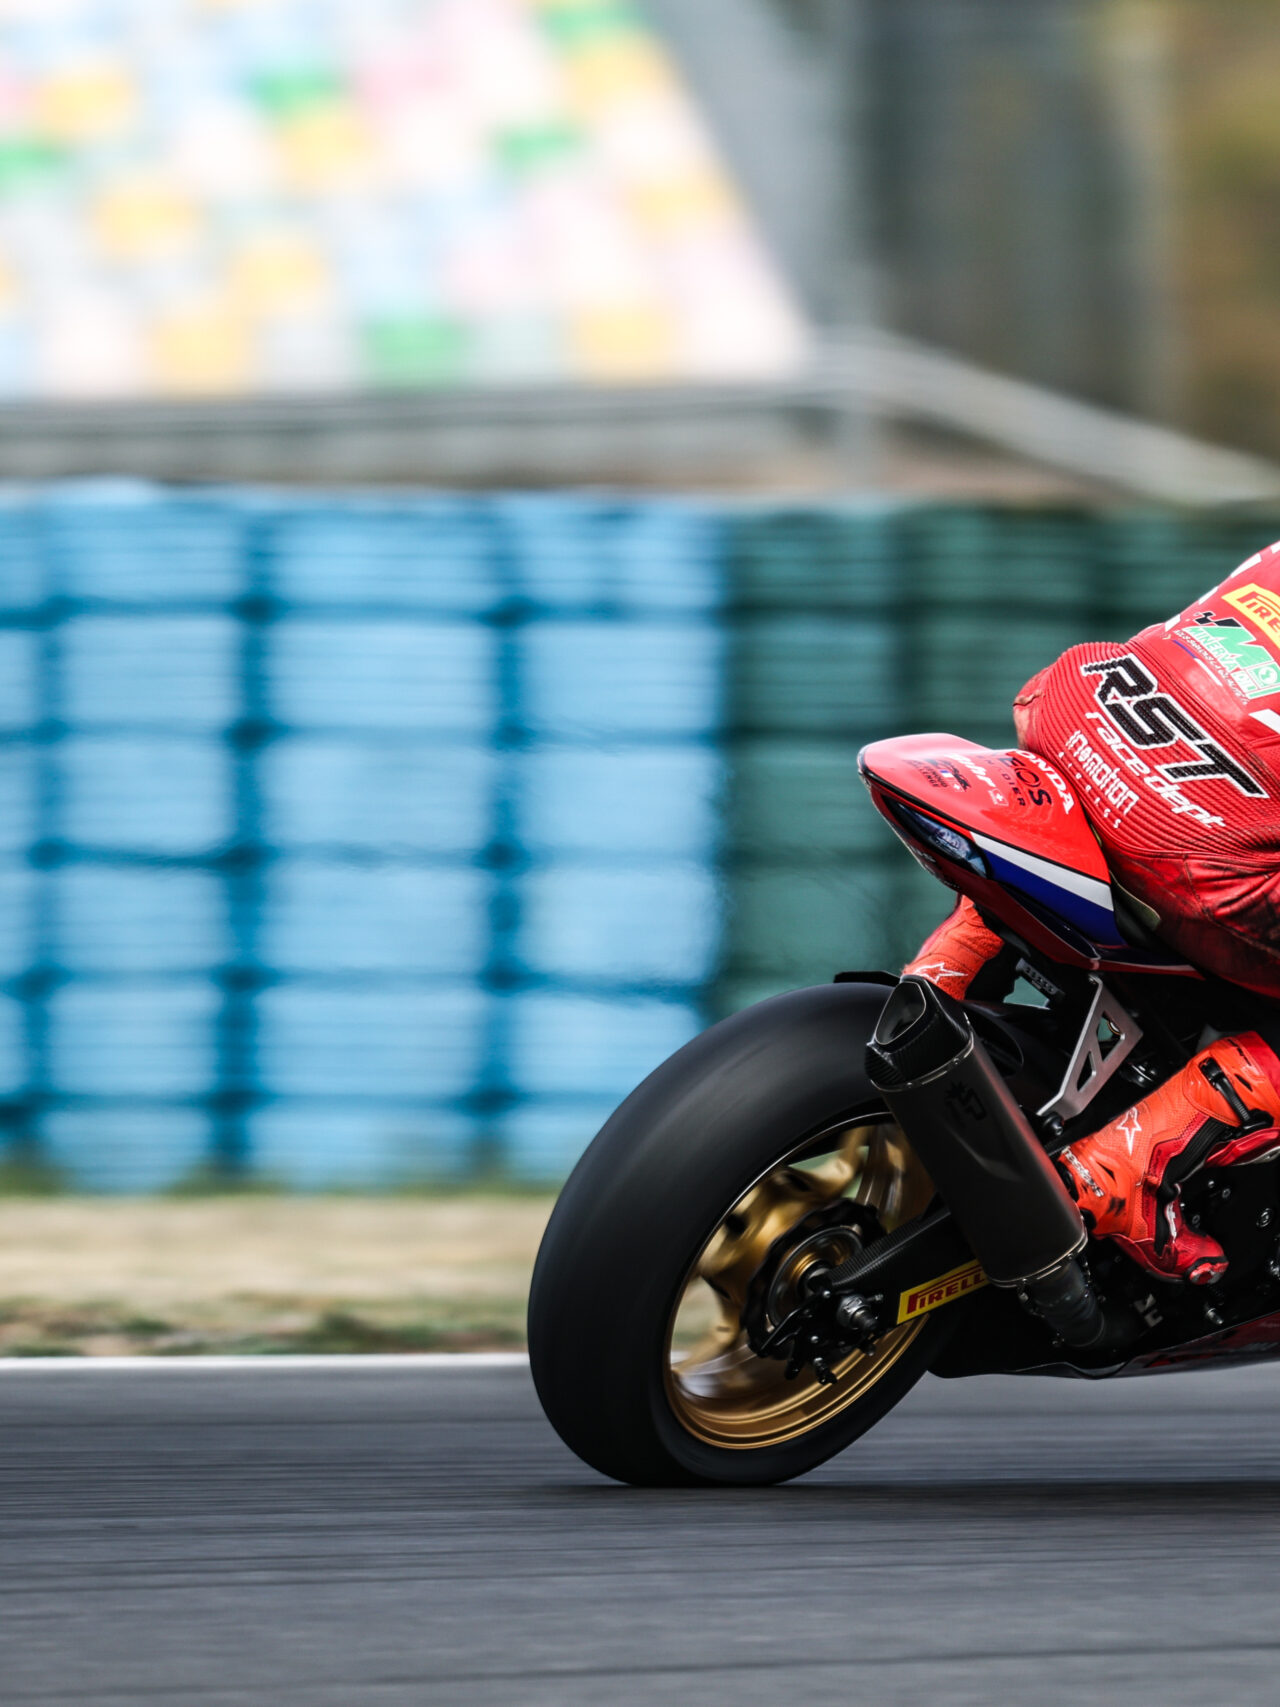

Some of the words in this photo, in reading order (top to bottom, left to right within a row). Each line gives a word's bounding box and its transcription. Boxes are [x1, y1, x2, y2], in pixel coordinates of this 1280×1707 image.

[1184, 626, 1239, 672] MINERVA
[1080, 652, 1270, 799] RST
[1010, 750, 1075, 815] ONDA
[1085, 711, 1151, 777] race
[1143, 774, 1226, 829] dept
[905, 1262, 987, 1316] PIRELL
